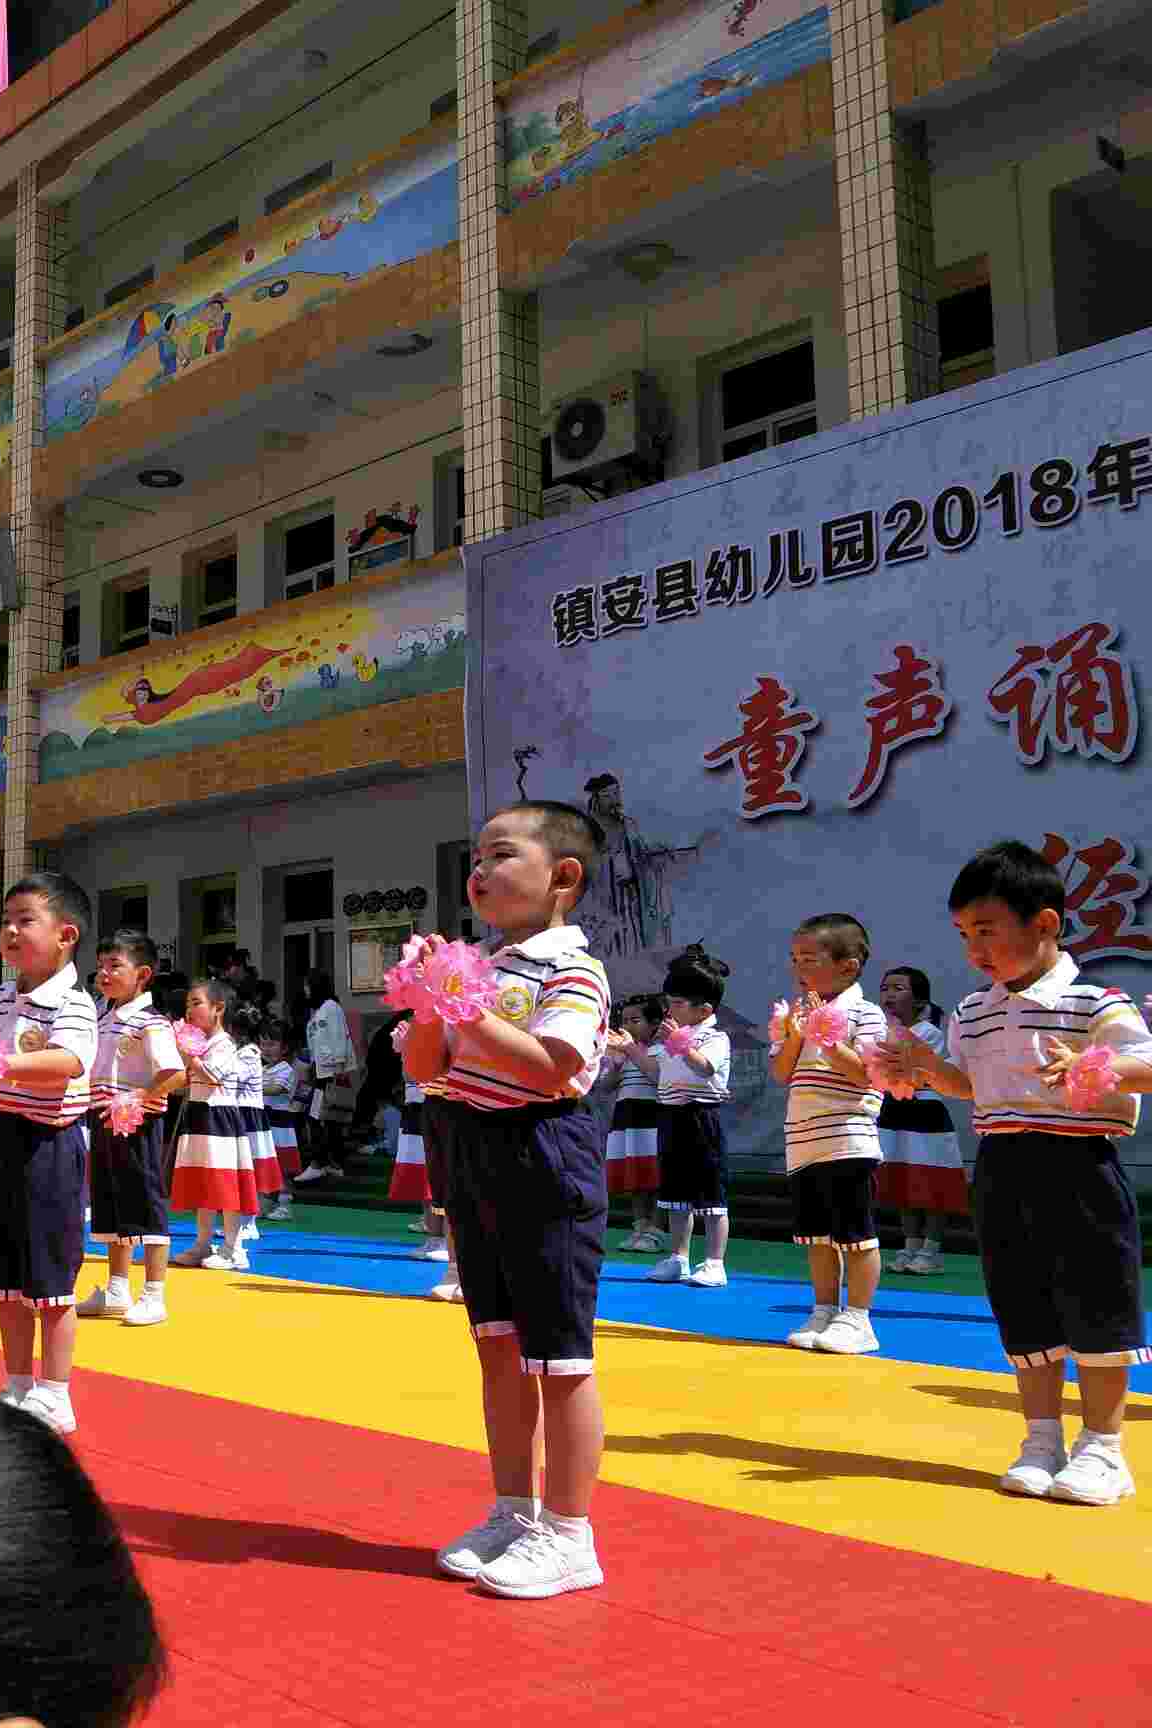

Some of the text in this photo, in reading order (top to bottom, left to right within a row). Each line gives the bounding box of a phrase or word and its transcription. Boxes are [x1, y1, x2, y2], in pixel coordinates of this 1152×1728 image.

[551, 435, 1152, 650] 镇安县幼儿园2018年
